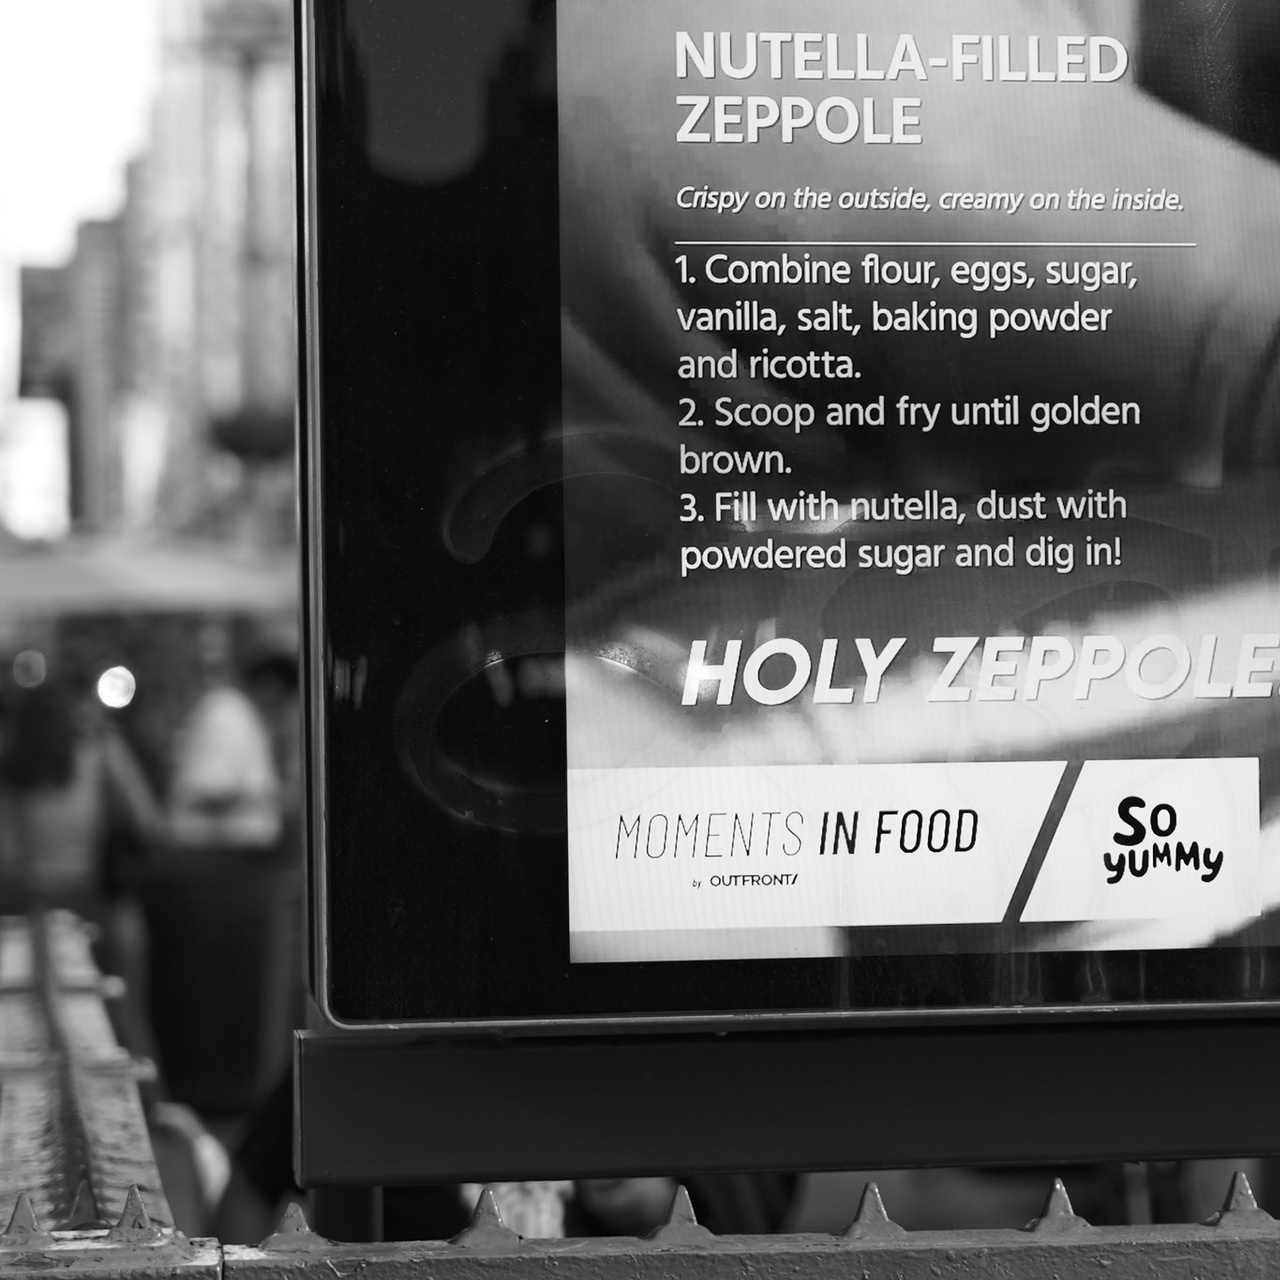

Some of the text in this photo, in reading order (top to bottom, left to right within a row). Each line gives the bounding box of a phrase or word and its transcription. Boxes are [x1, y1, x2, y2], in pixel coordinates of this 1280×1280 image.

[675, 31, 1130, 83] NUTELLA-FILLED
[675, 95, 924, 144] ZEPPOLE
[676, 186, 1185, 215] Crispy on the outside, creamy on the inside.
[675, 254, 1138, 292] 1. Combine flour, eggs, sugar,
[677, 300, 1113, 338] vanilla, salt, baking powder
[677, 349, 861, 380] and ricotta.
[678, 395, 1141, 432] 2. Scoop and fry until golden
[679, 444, 792, 475] brown.
[679, 489, 1128, 524] 3. Fill with nutella, dust with
[680, 536, 1122, 576] powdered sugar and dig in!
[680, 636, 907, 707] HOLY
[614, 808, 979, 861] MOMENTS IN FOOD
[692, 879, 702, 889] by
